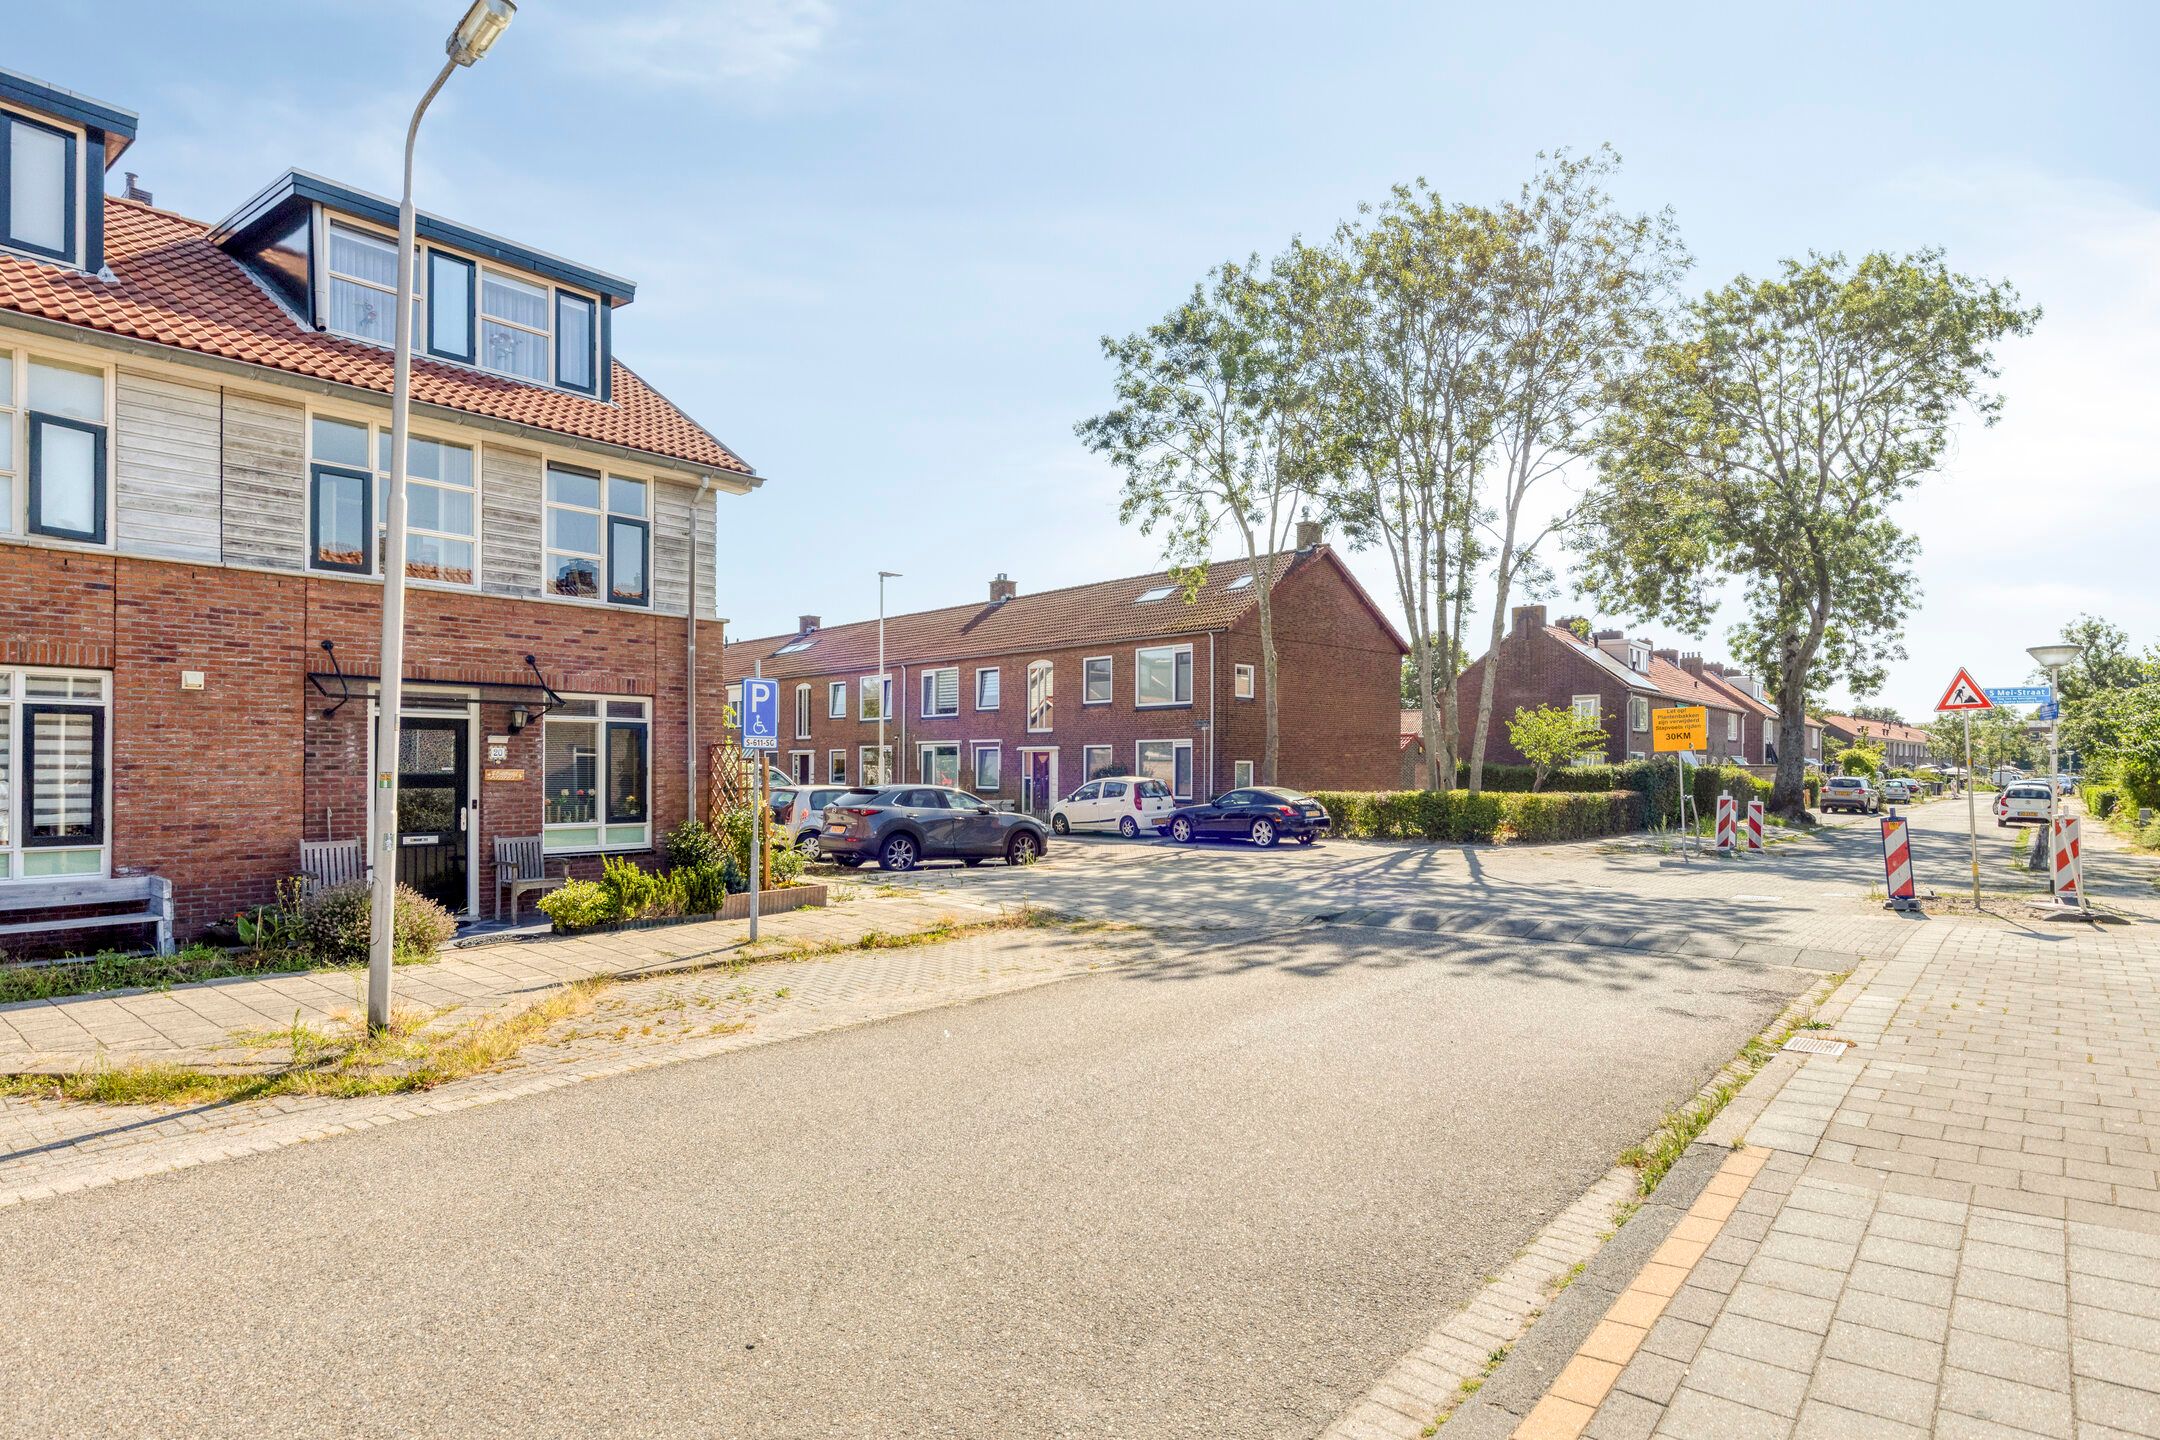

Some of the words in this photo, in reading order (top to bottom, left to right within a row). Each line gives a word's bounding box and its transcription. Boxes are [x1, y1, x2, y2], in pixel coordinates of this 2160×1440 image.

[751, 683, 770, 713] P
[1665, 732, 1691, 740] 30KM
[494, 748, 503, 757] 20
